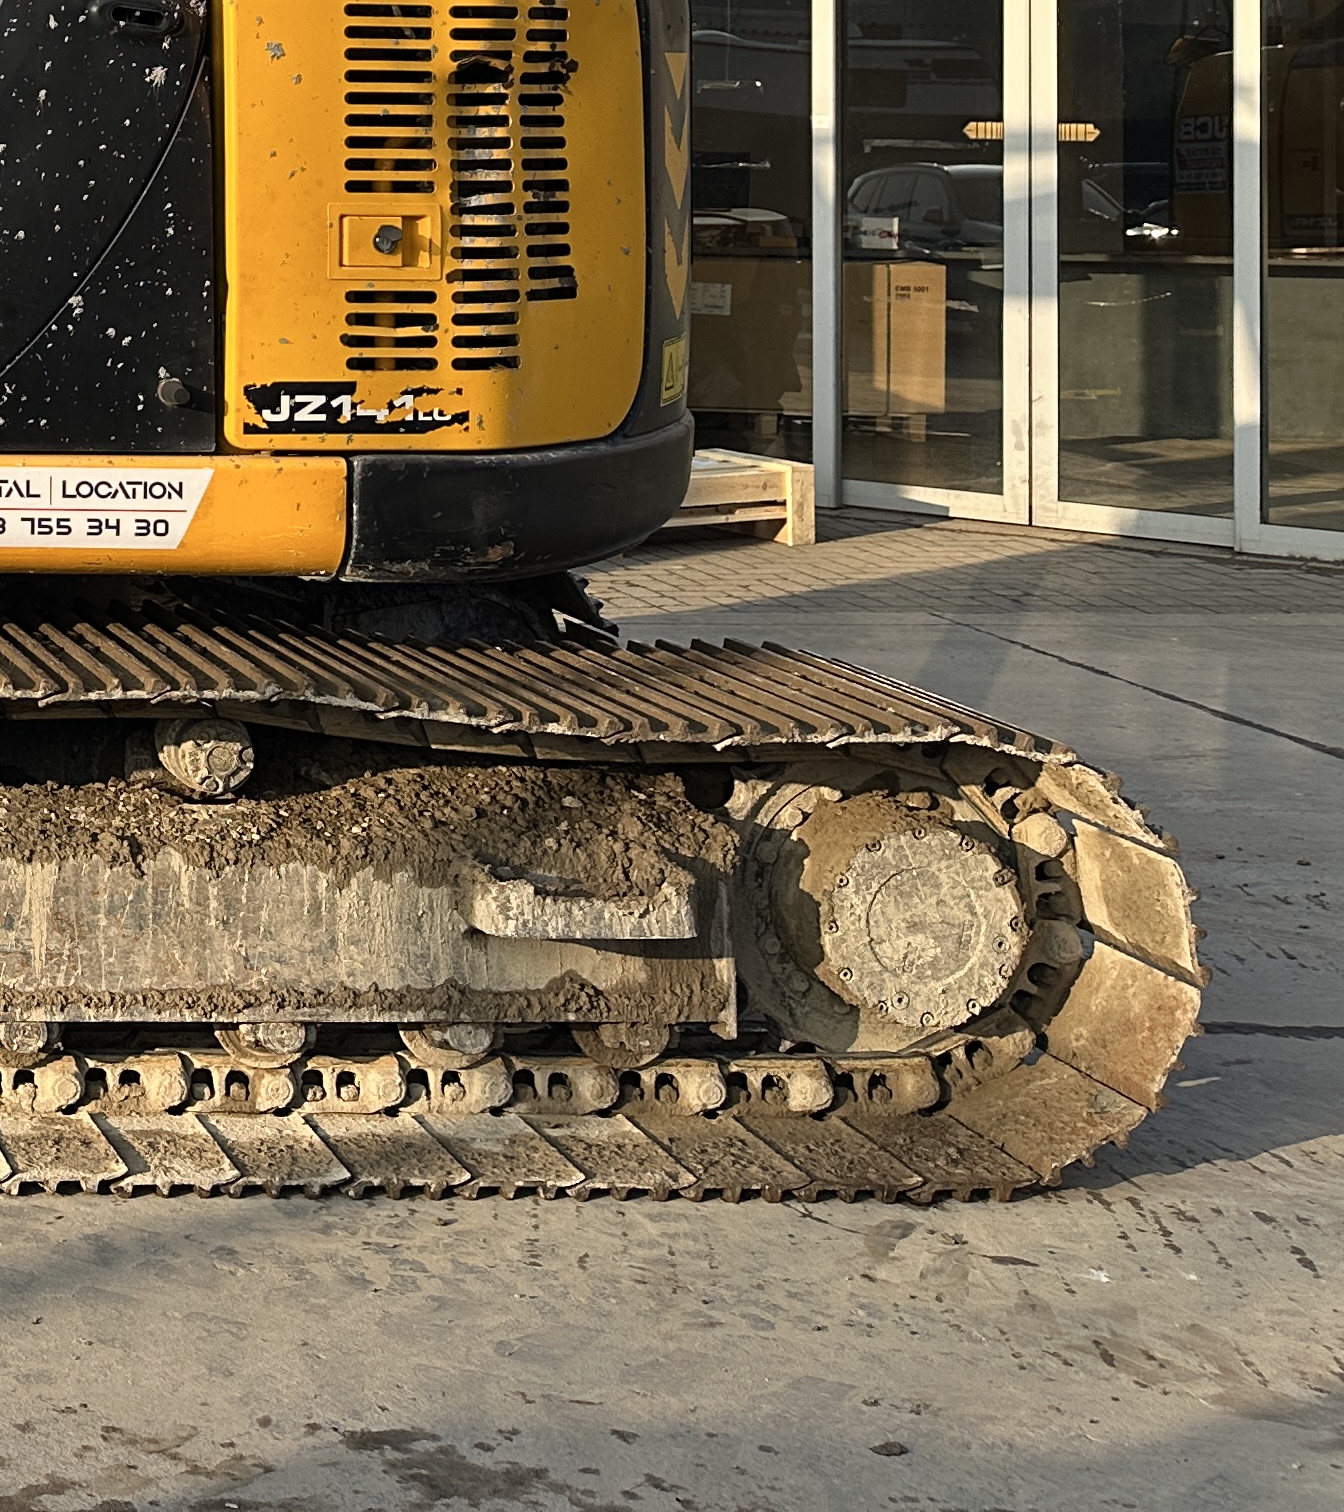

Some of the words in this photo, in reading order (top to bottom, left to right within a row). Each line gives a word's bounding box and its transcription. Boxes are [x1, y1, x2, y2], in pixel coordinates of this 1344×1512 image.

[62, 480, 183, 500] LOCATION
[21, 517, 72, 536] 755
[86, 518, 121, 536] 34
[134, 519, 169, 537] 30
